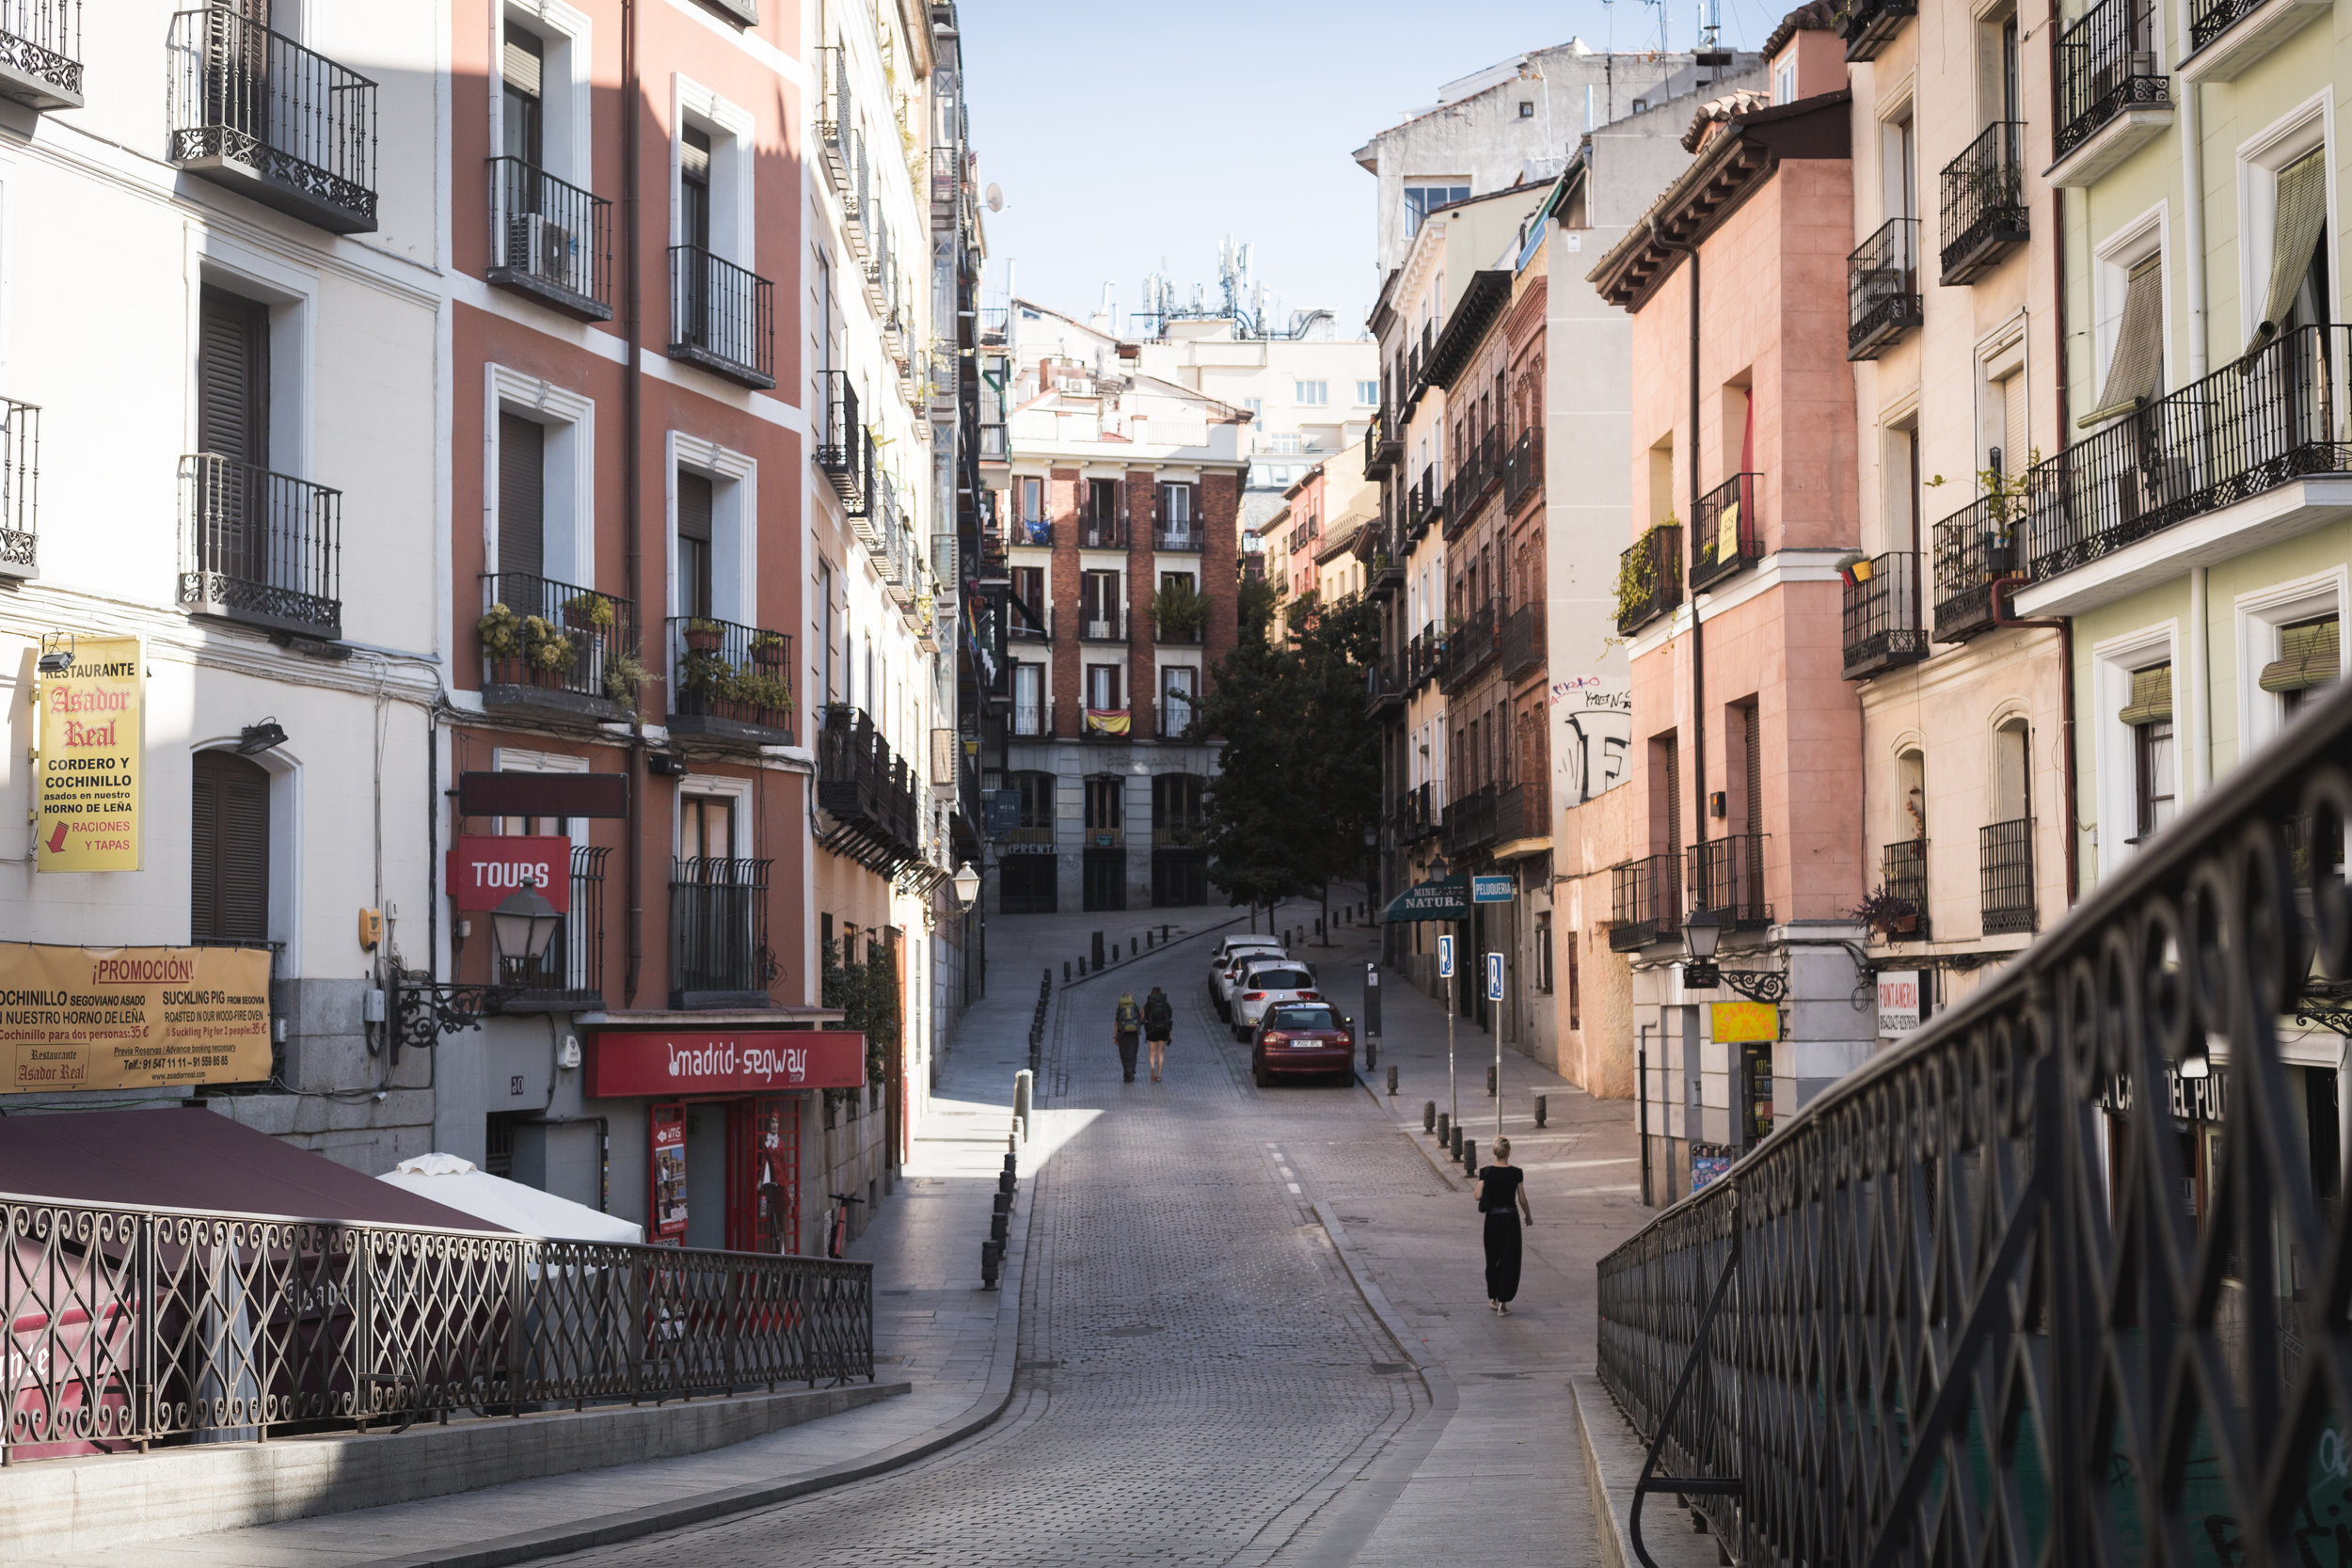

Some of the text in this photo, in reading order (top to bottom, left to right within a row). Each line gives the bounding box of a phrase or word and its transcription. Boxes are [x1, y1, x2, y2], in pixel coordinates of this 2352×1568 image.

[51, 686, 130, 714] Asador
[64, 719, 117, 747] Real
[48, 757, 130, 771] CORDERO Y
[45, 774, 132, 788] COCHINILLO
[44, 792, 77, 800] asados
[44, 801, 132, 814] HORNO DE LEÑA
[72, 821, 130, 832] RACIONES
[85, 840, 130, 850] Y TAPAS
[471, 862, 549, 888] TOURS
[1475, 882, 1512, 895] PELUQUERIA
[1441, 940, 1448, 971] P
[92, 956, 194, 985] ¡PROMOCIÓN!
[1367, 962, 1375, 972] P
[1490, 958, 1498, 994] P
[70, 995, 119, 1006] SEGOVIANO
[120, 995, 146, 1006] ASADO
[162, 990, 265, 1005] SUCKLING PIG FROM SEGOVIA
[6, 1011, 61, 1024] NUESTRO
[63, 1011, 103, 1024] HORNO
[104, 1011, 118, 1023] DE
[119, 1007, 146, 1023] LEÑA
[165, 1009, 263, 1022] ROASTED IN OUR WOOD-FIRE OVEN
[48, 1031, 71, 1042] para
[72, 1028, 87, 1039] dos
[142, 1025, 150, 1038] €
[171, 1026, 202, 1038] Suckling
[203, 1026, 213, 1038] Pig
[214, 1025, 223, 1036] for
[261, 1022, 267, 1035] €
[30, 1049, 77, 1061] Restaurante
[114, 1046, 134, 1055] Previa
[135, 1045, 162, 1055] Reservas
[166, 1044, 191, 1054] Advance
[191, 1043, 212, 1054] booking
[143, 1058, 151, 1069] 91
[152, 1058, 167, 1069] 547
[167, 1057, 176, 1069] 11
[178, 1057, 186, 1068] 11
[193, 1056, 200, 1067] 91
[675, 1041, 808, 1083] madrid-segway
[18, 1064, 86, 1082] Asador Real
